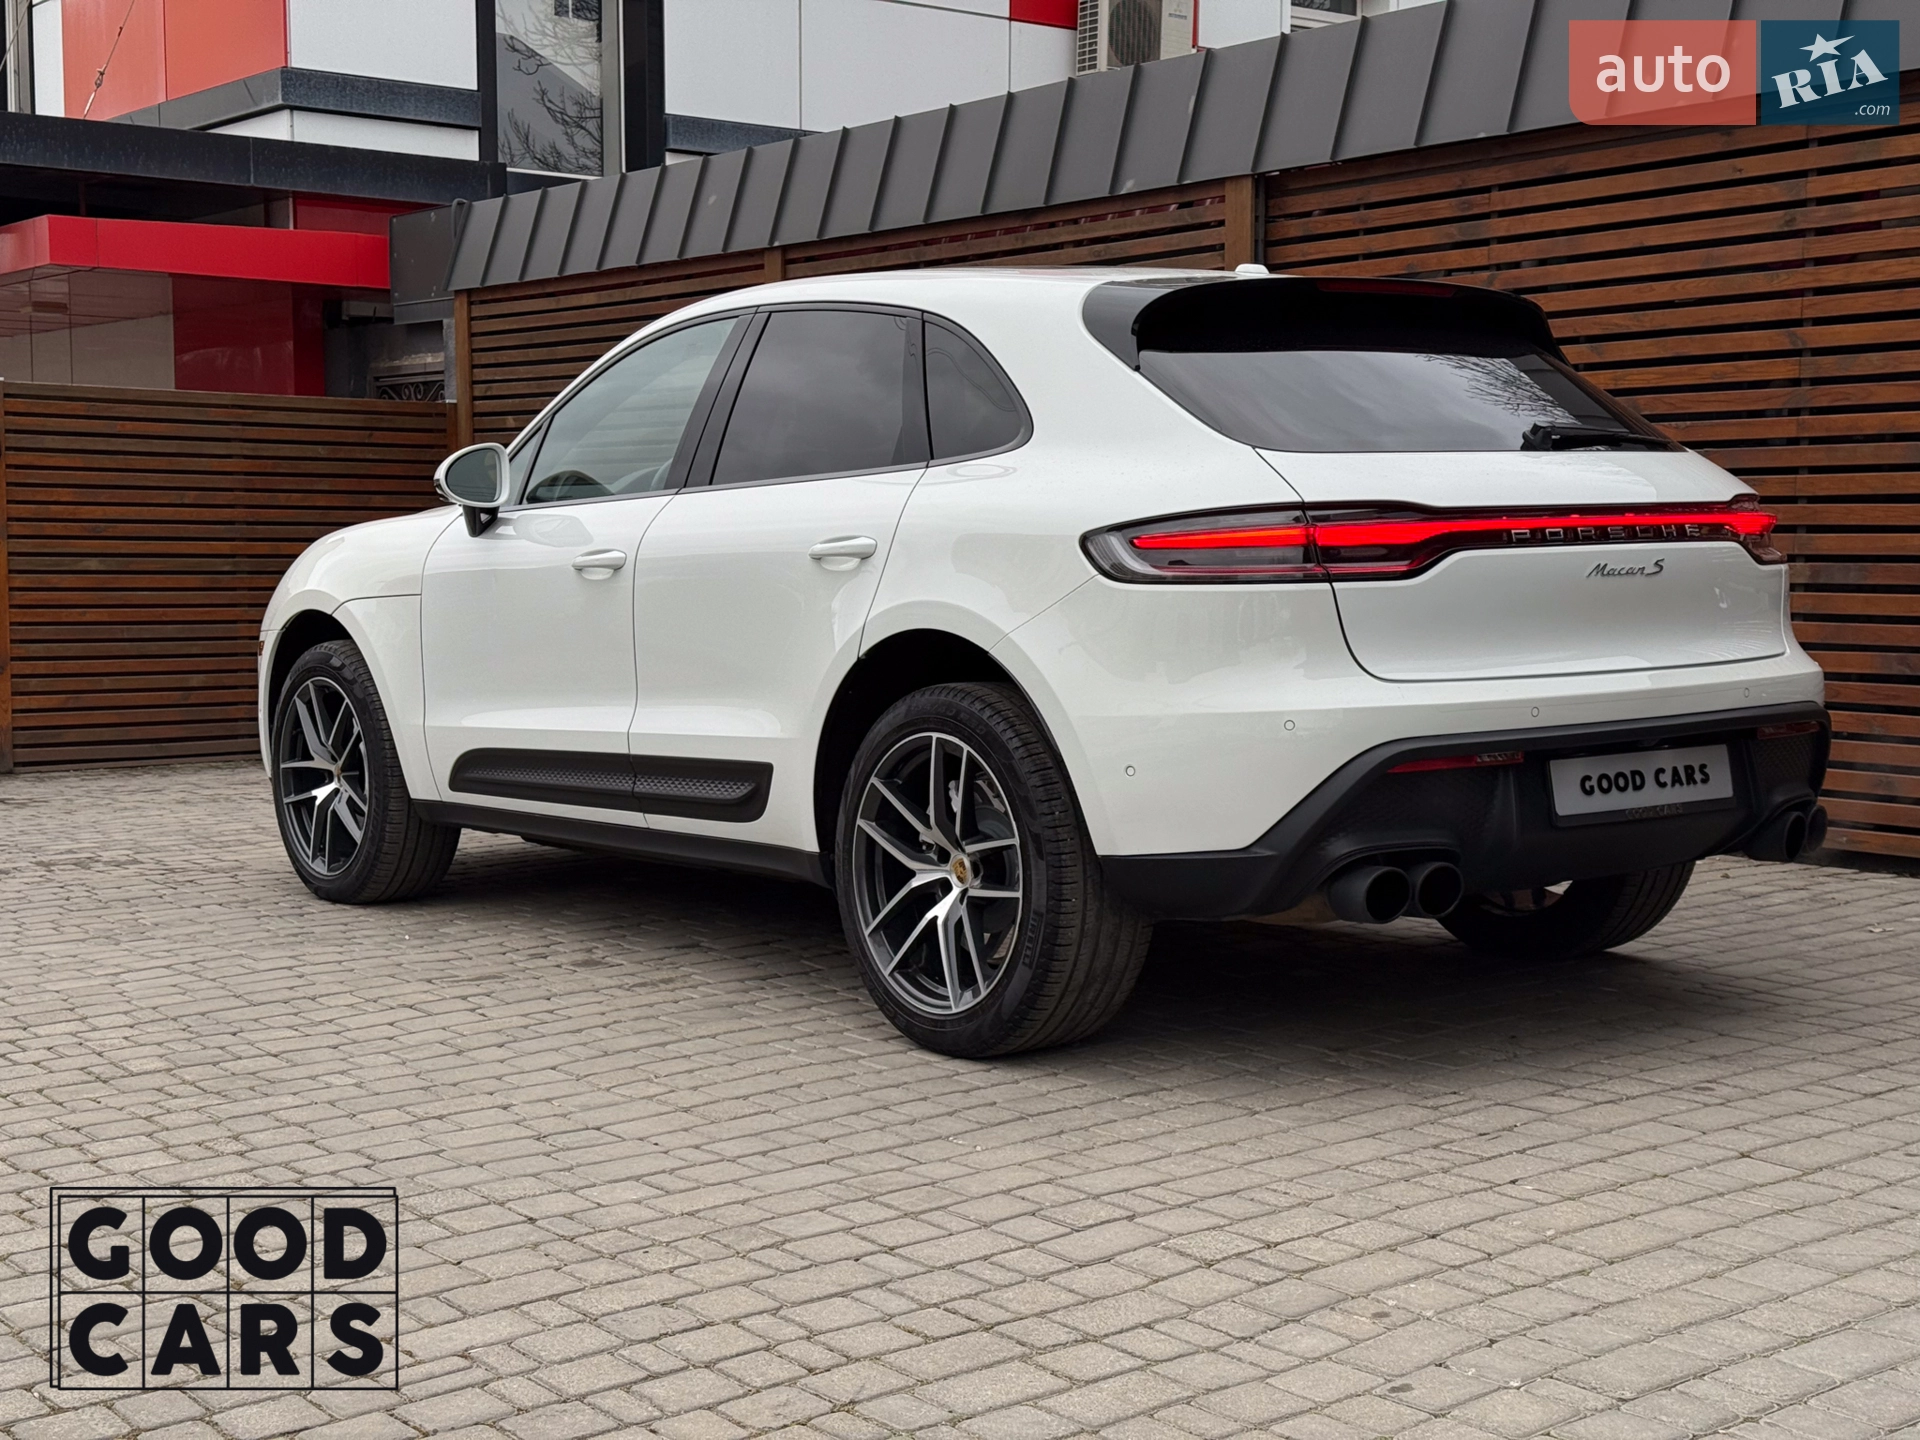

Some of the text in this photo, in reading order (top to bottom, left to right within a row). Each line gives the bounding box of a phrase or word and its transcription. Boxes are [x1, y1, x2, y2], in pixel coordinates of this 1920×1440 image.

[1510, 523, 1700, 542] PORSCHE
[1585, 557, 1666, 578] Macan S
[1579, 763, 1711, 796] GOOD CARS
